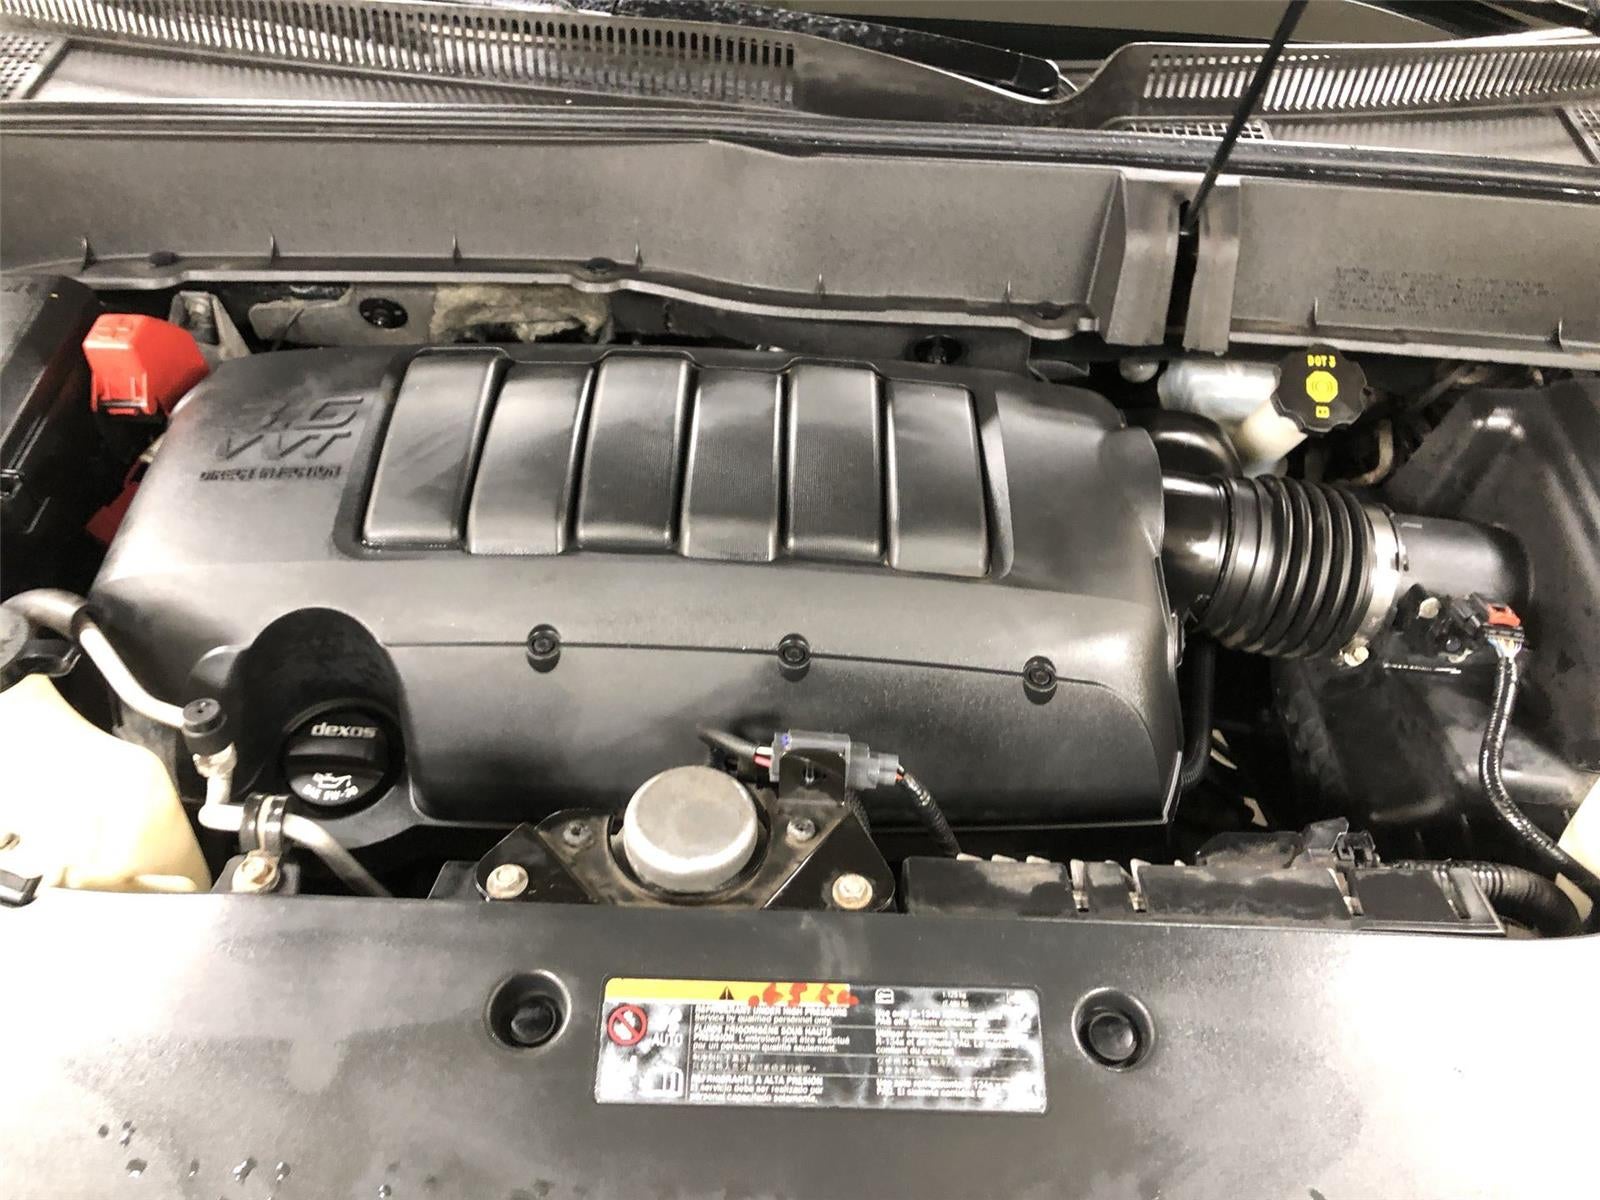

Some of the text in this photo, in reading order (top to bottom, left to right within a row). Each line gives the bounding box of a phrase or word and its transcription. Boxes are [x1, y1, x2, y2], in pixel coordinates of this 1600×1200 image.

[1307, 354, 1328, 367] DOT
[216, 431, 352, 460] VVT
[311, 722, 379, 738] dexos
[652, 1031, 684, 1047] AUTO
